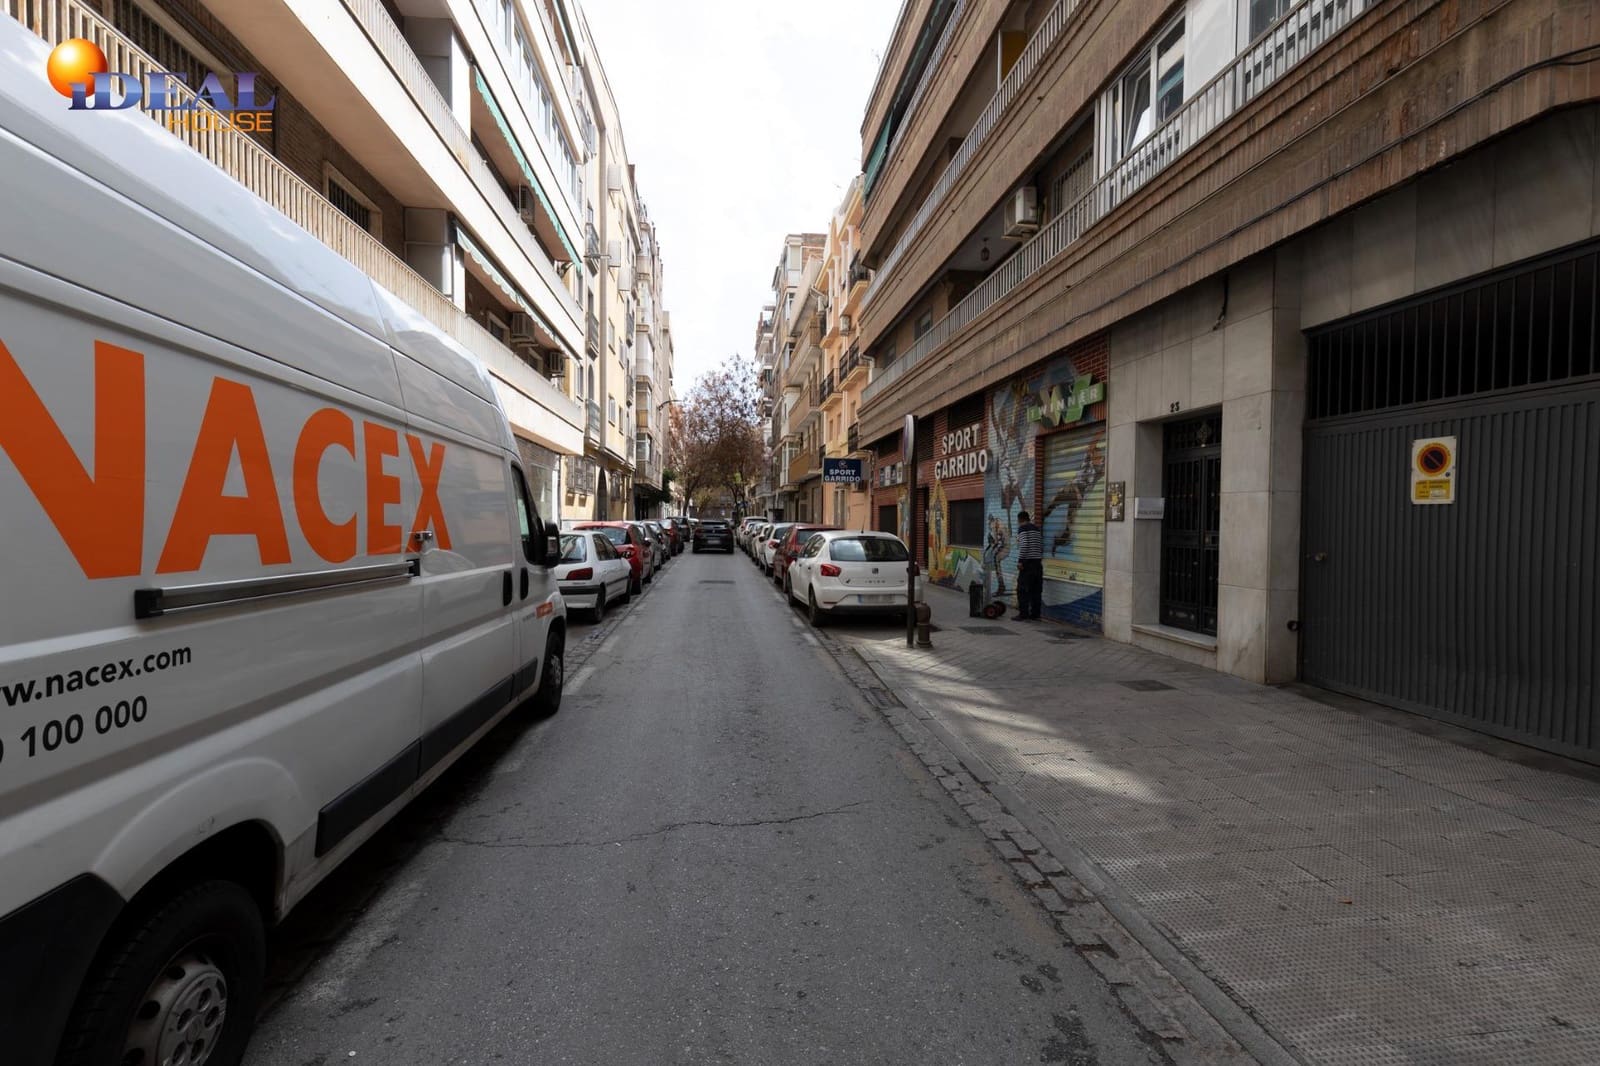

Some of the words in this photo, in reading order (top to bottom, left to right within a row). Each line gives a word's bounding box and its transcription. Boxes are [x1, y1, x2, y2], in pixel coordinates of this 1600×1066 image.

[0, 337, 452, 580] NACEX
[934, 449, 988, 480] GARRIDO
[942, 423, 980, 455] SPORT
[0, 646, 192, 706] w.nacex.com
[20, 714, 83, 757] 100
[95, 695, 147, 734] 000
